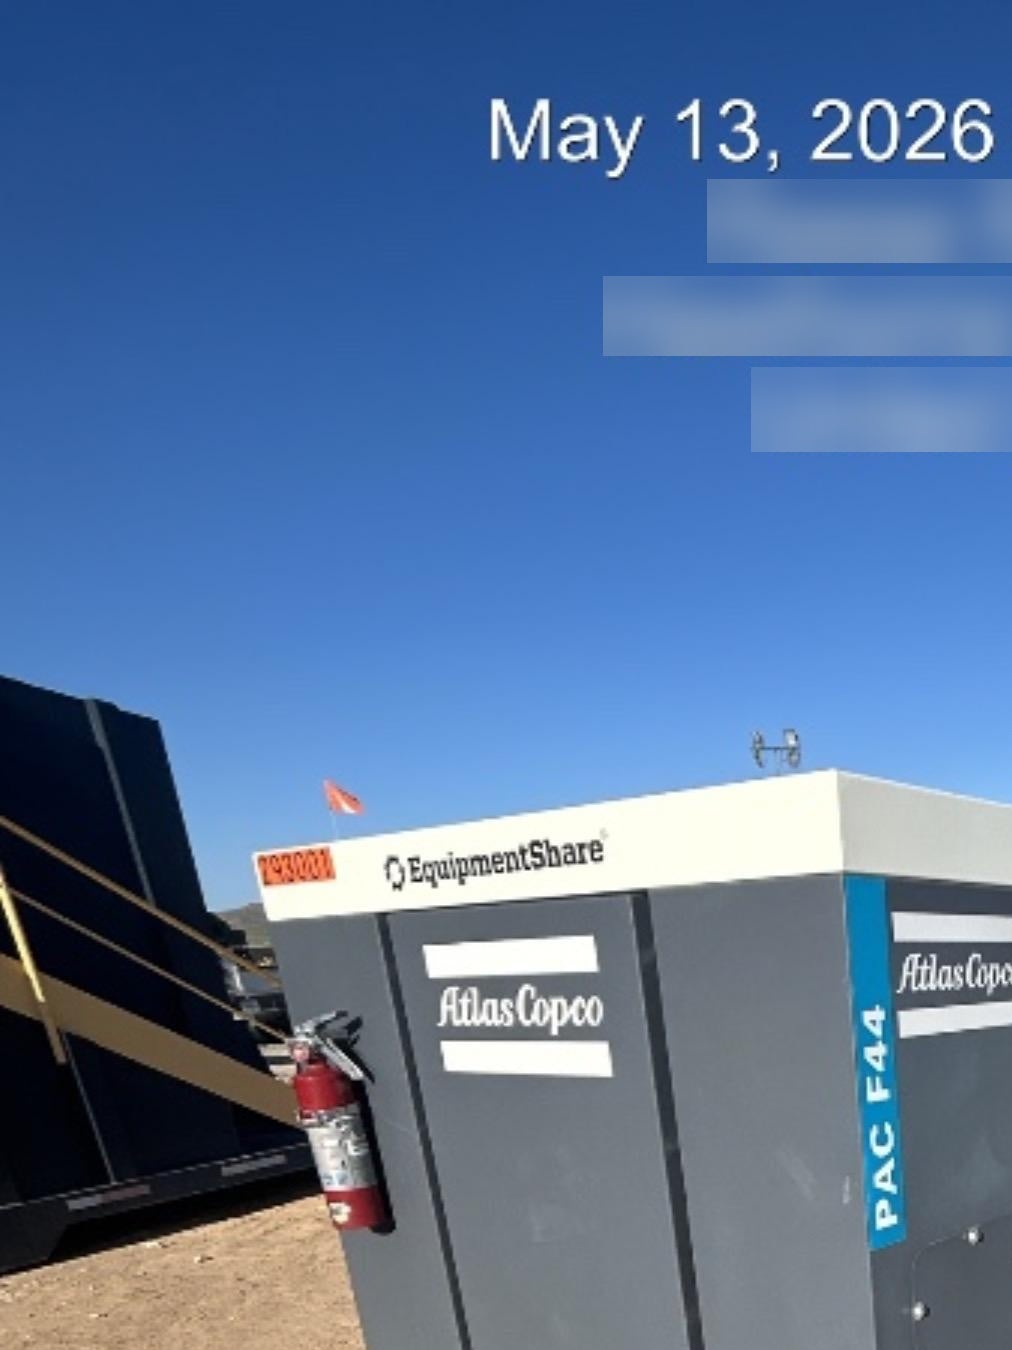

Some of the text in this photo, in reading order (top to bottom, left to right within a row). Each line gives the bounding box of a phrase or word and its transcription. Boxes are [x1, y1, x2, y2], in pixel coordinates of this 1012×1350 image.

[406, 837, 605, 889] EquipmentShare
[436, 983, 605, 1037] Atlas Copco
[862, 1003, 899, 1232] PAC F44
